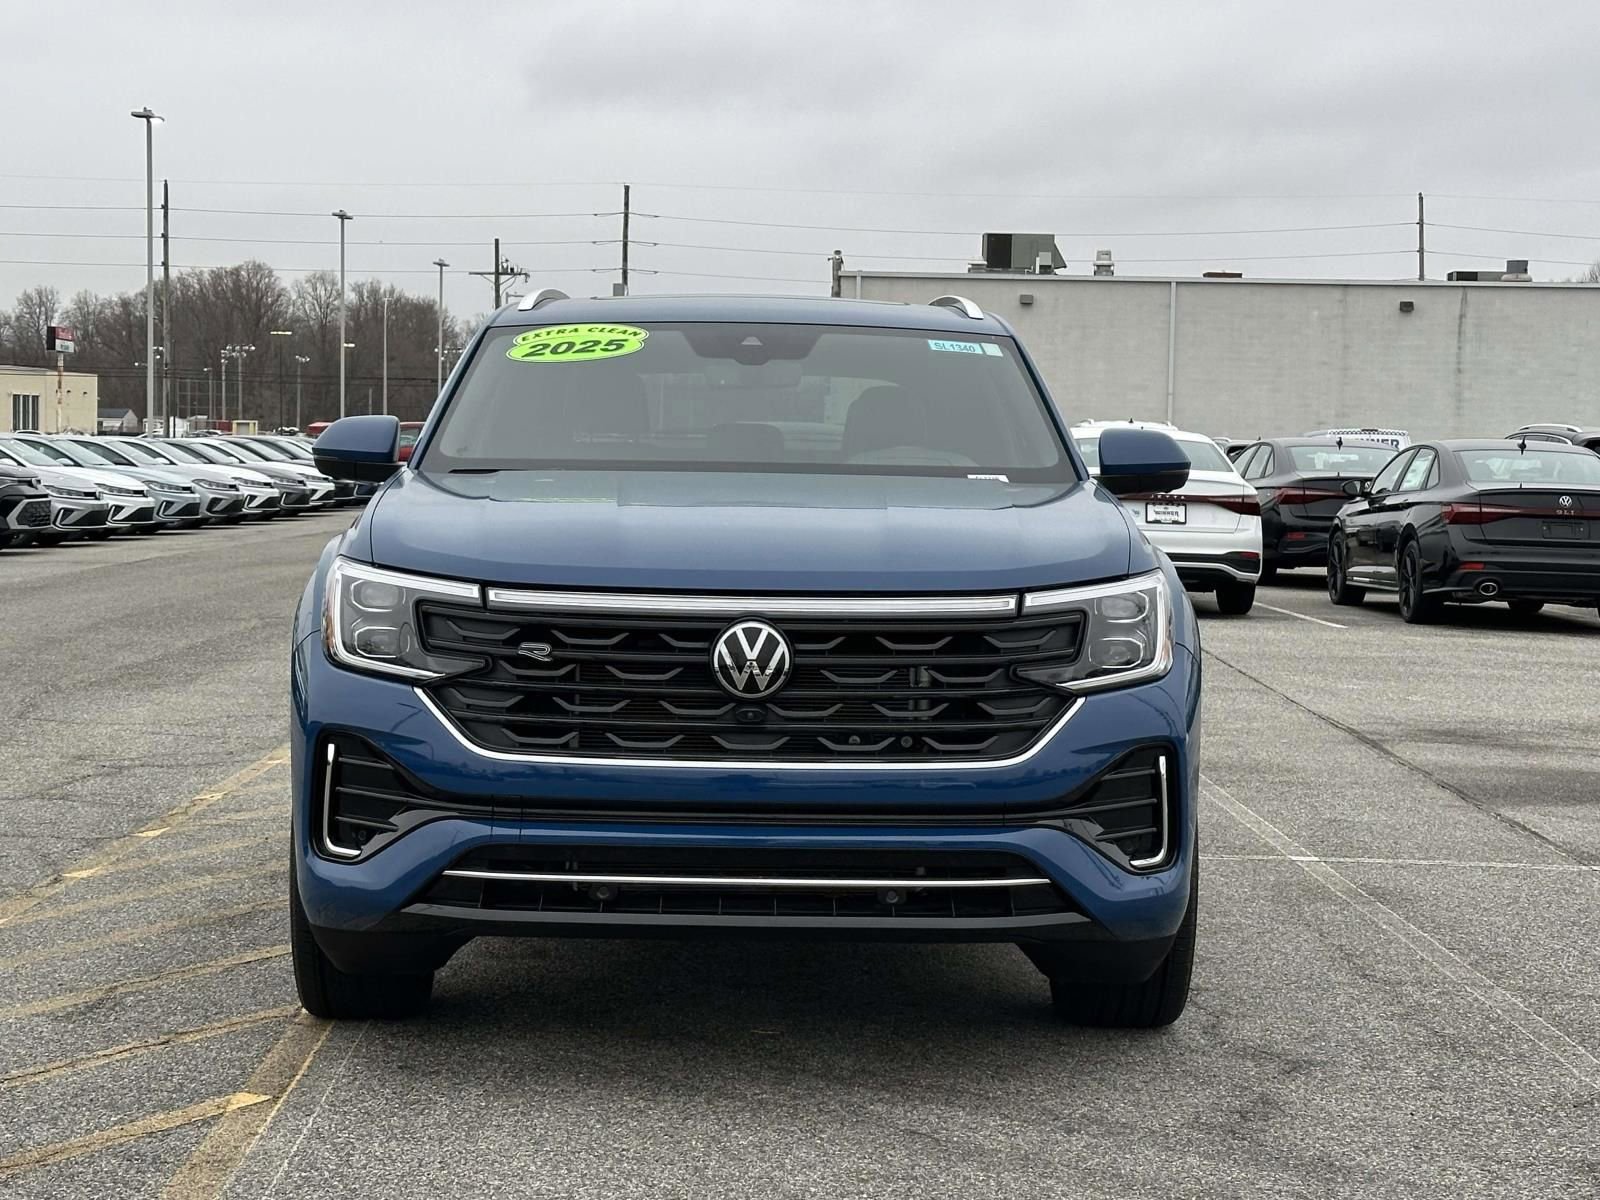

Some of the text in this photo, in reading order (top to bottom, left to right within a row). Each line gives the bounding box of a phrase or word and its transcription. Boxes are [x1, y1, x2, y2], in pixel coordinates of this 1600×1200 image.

[521, 326, 642, 342] EXTRA CLEAN
[521, 338, 629, 358] 2025
[934, 342, 976, 353] SL1340
